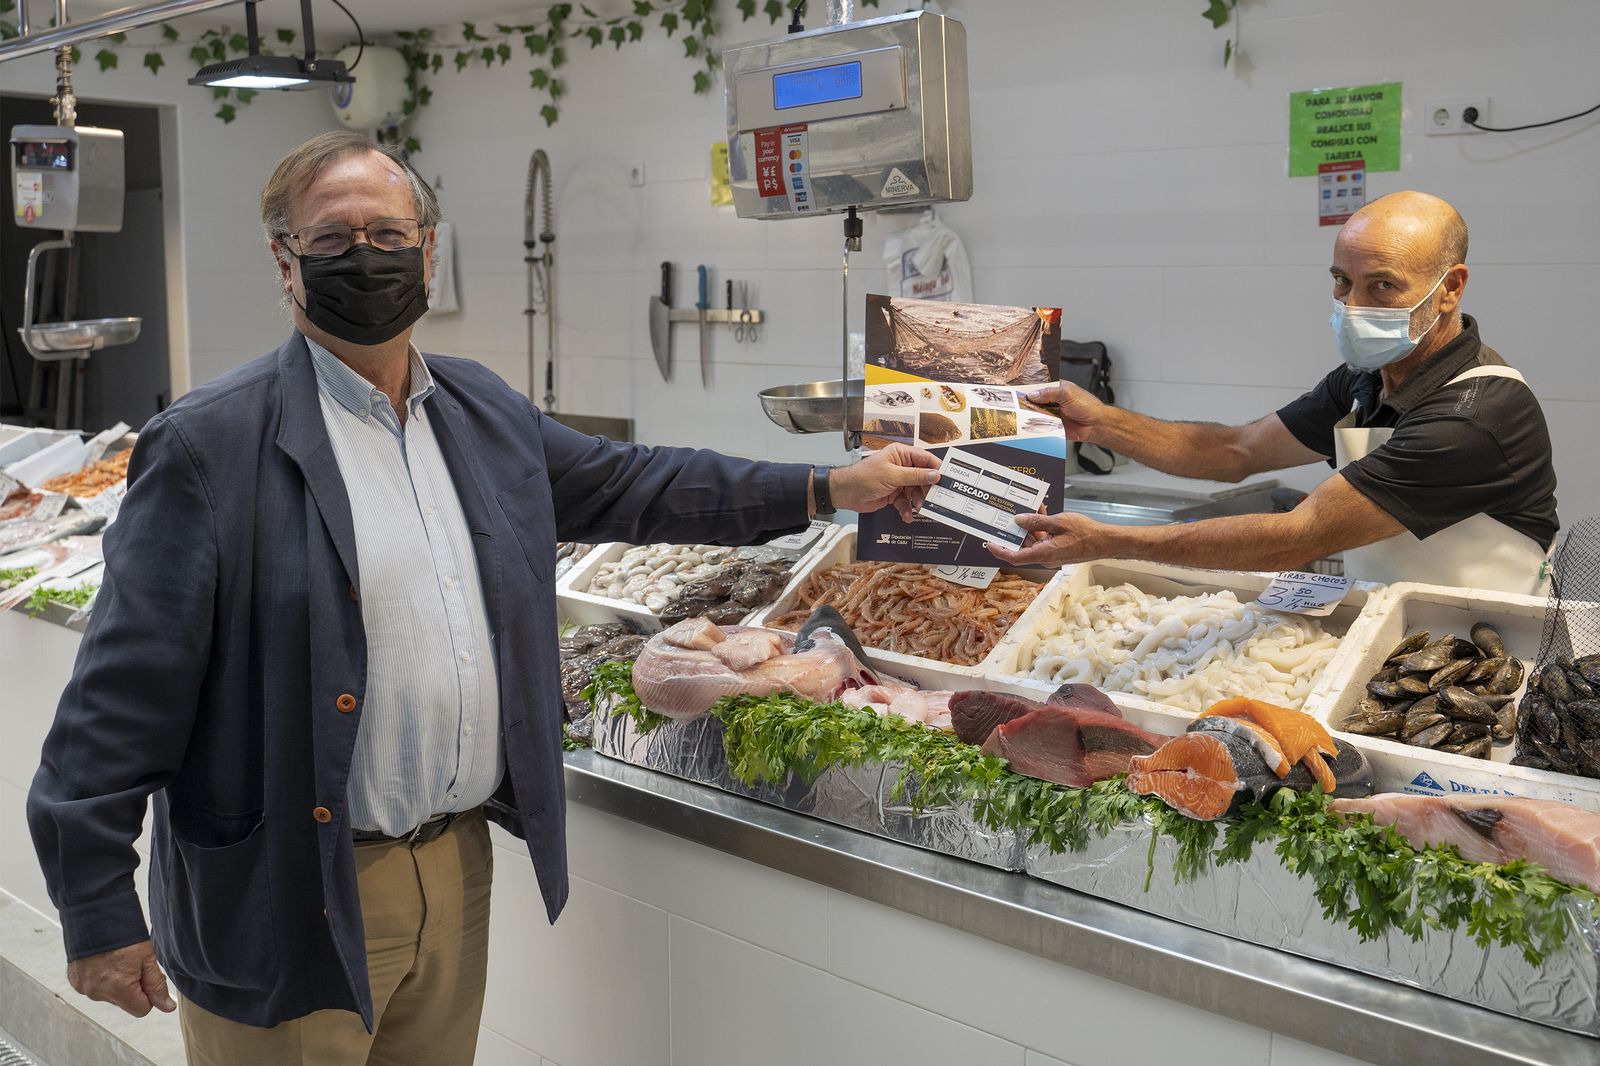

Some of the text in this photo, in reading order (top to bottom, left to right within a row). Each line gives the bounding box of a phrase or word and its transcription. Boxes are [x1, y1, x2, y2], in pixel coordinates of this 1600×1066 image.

[1305, 97, 1330, 107] PARA
[1349, 92, 1383, 103] MAYOR
[1314, 107, 1373, 120] COMODIDAD
[1316, 122, 1372, 134] REALICE SUS
[1310, 136, 1377, 148] COMPRAS CON
[762, 148, 774, 157] your
[1325, 151, 1363, 160] TARJETA
[758, 155, 780, 163] currency
[885, 184, 915, 193] MINERVA
[949, 466, 971, 479] DORADA
[952, 481, 990, 501] PESCADO
[998, 497, 1015, 508] ESTERO
[988, 500, 1016, 515] TRADICIONAL
[1278, 571, 1348, 585] TIRAS CHOCOS
[1303, 600, 1326, 608] KILO
